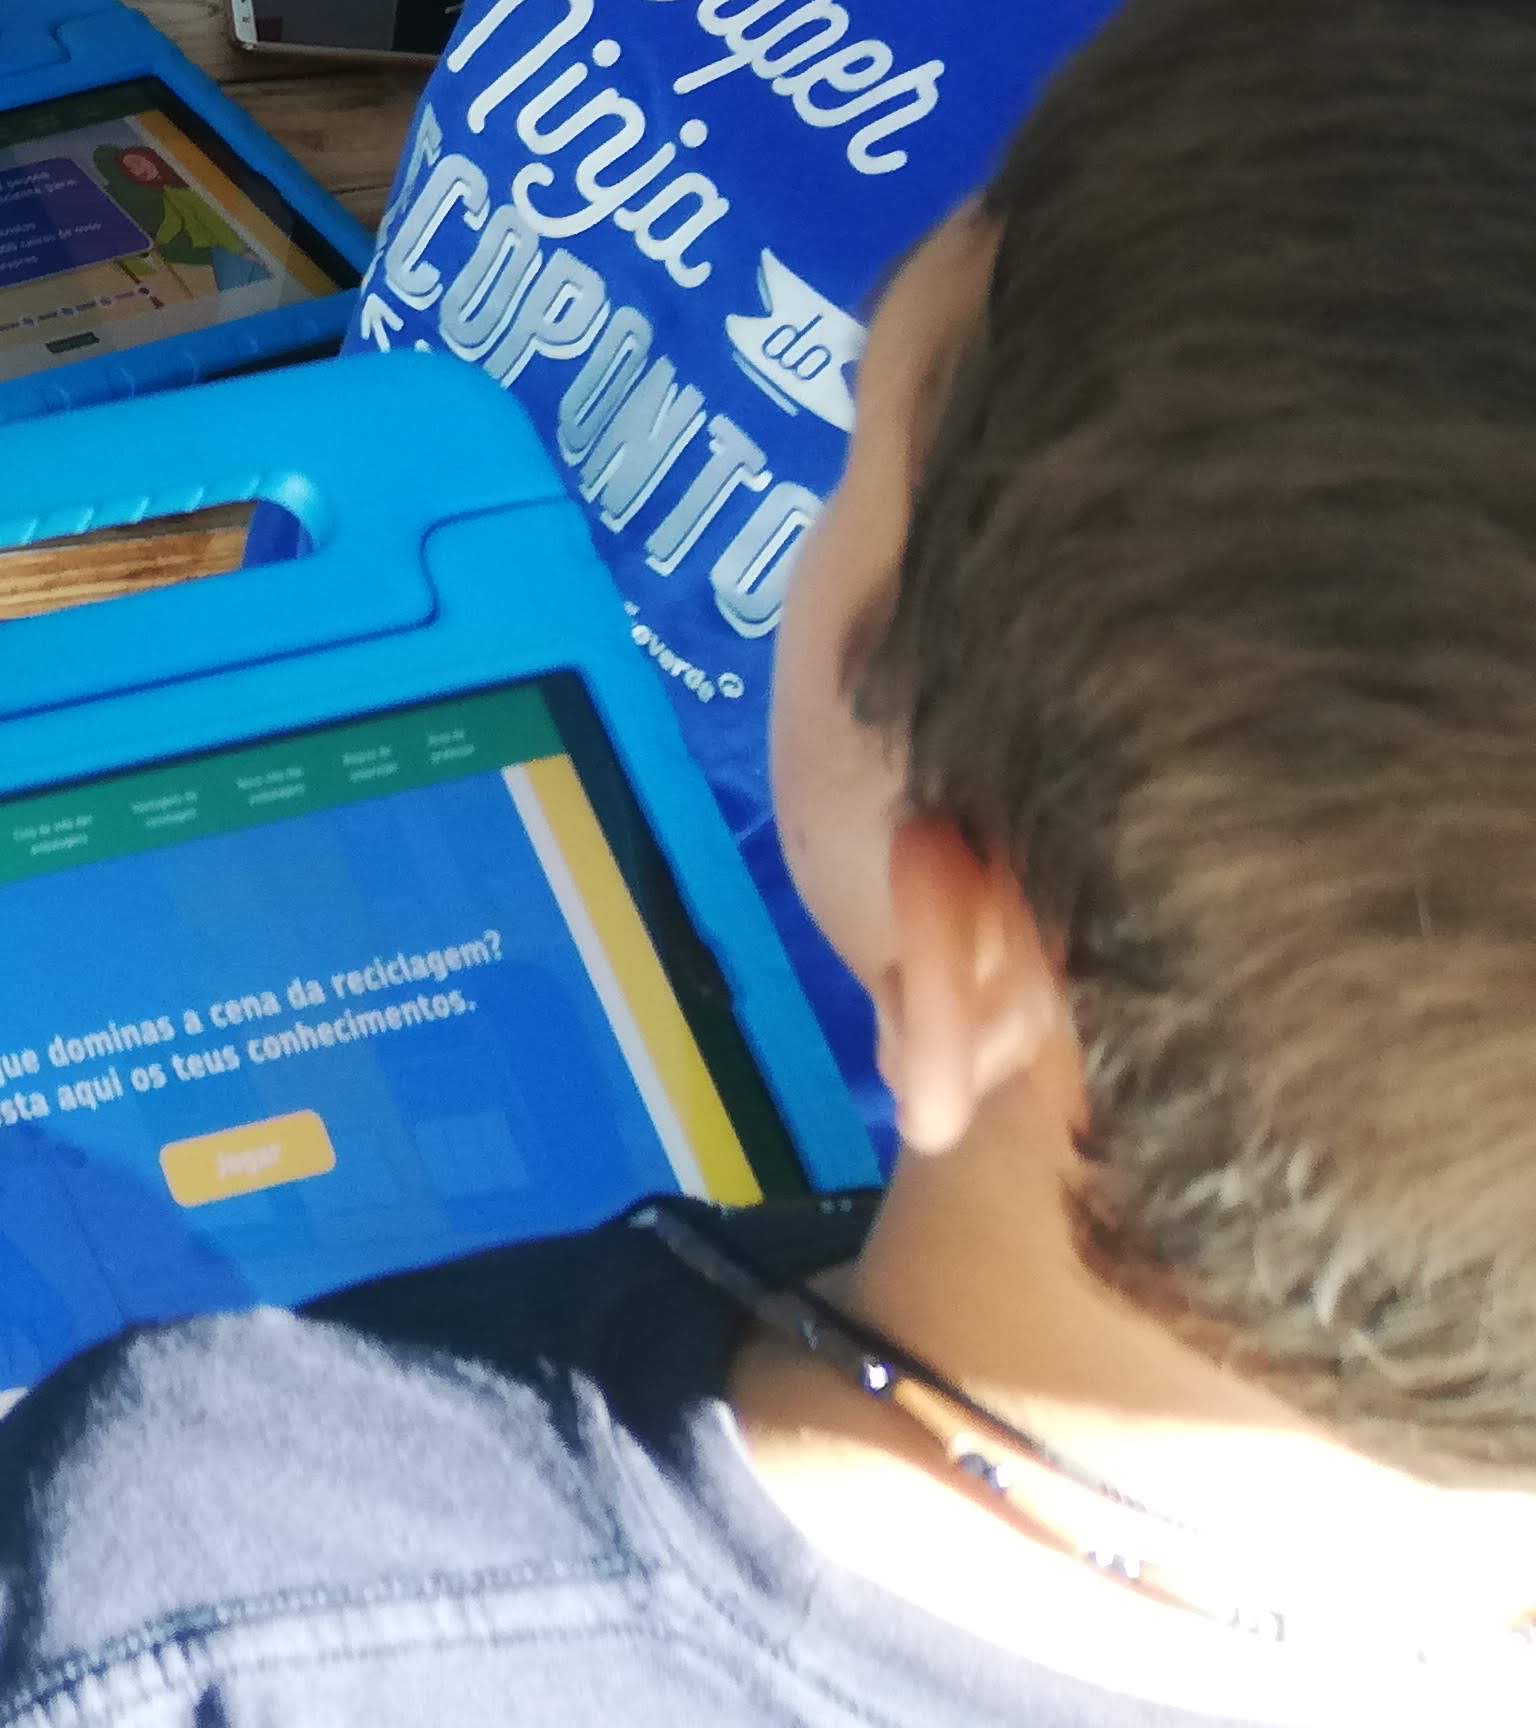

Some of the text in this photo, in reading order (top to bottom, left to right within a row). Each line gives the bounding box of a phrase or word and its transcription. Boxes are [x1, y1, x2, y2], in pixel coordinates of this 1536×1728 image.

[761, 314, 834, 382] do
[48, 1015, 175, 1068] dominas
[182, 1009, 204, 1035] a
[209, 991, 282, 1028] cena
[286, 977, 326, 1011] da
[330, 929, 503, 1000] reciclagem?
[57, 1066, 124, 1111] aqui
[130, 1063, 167, 1093] os
[170, 1044, 241, 1081] teus
[246, 989, 477, 1066] conhecimentos.
